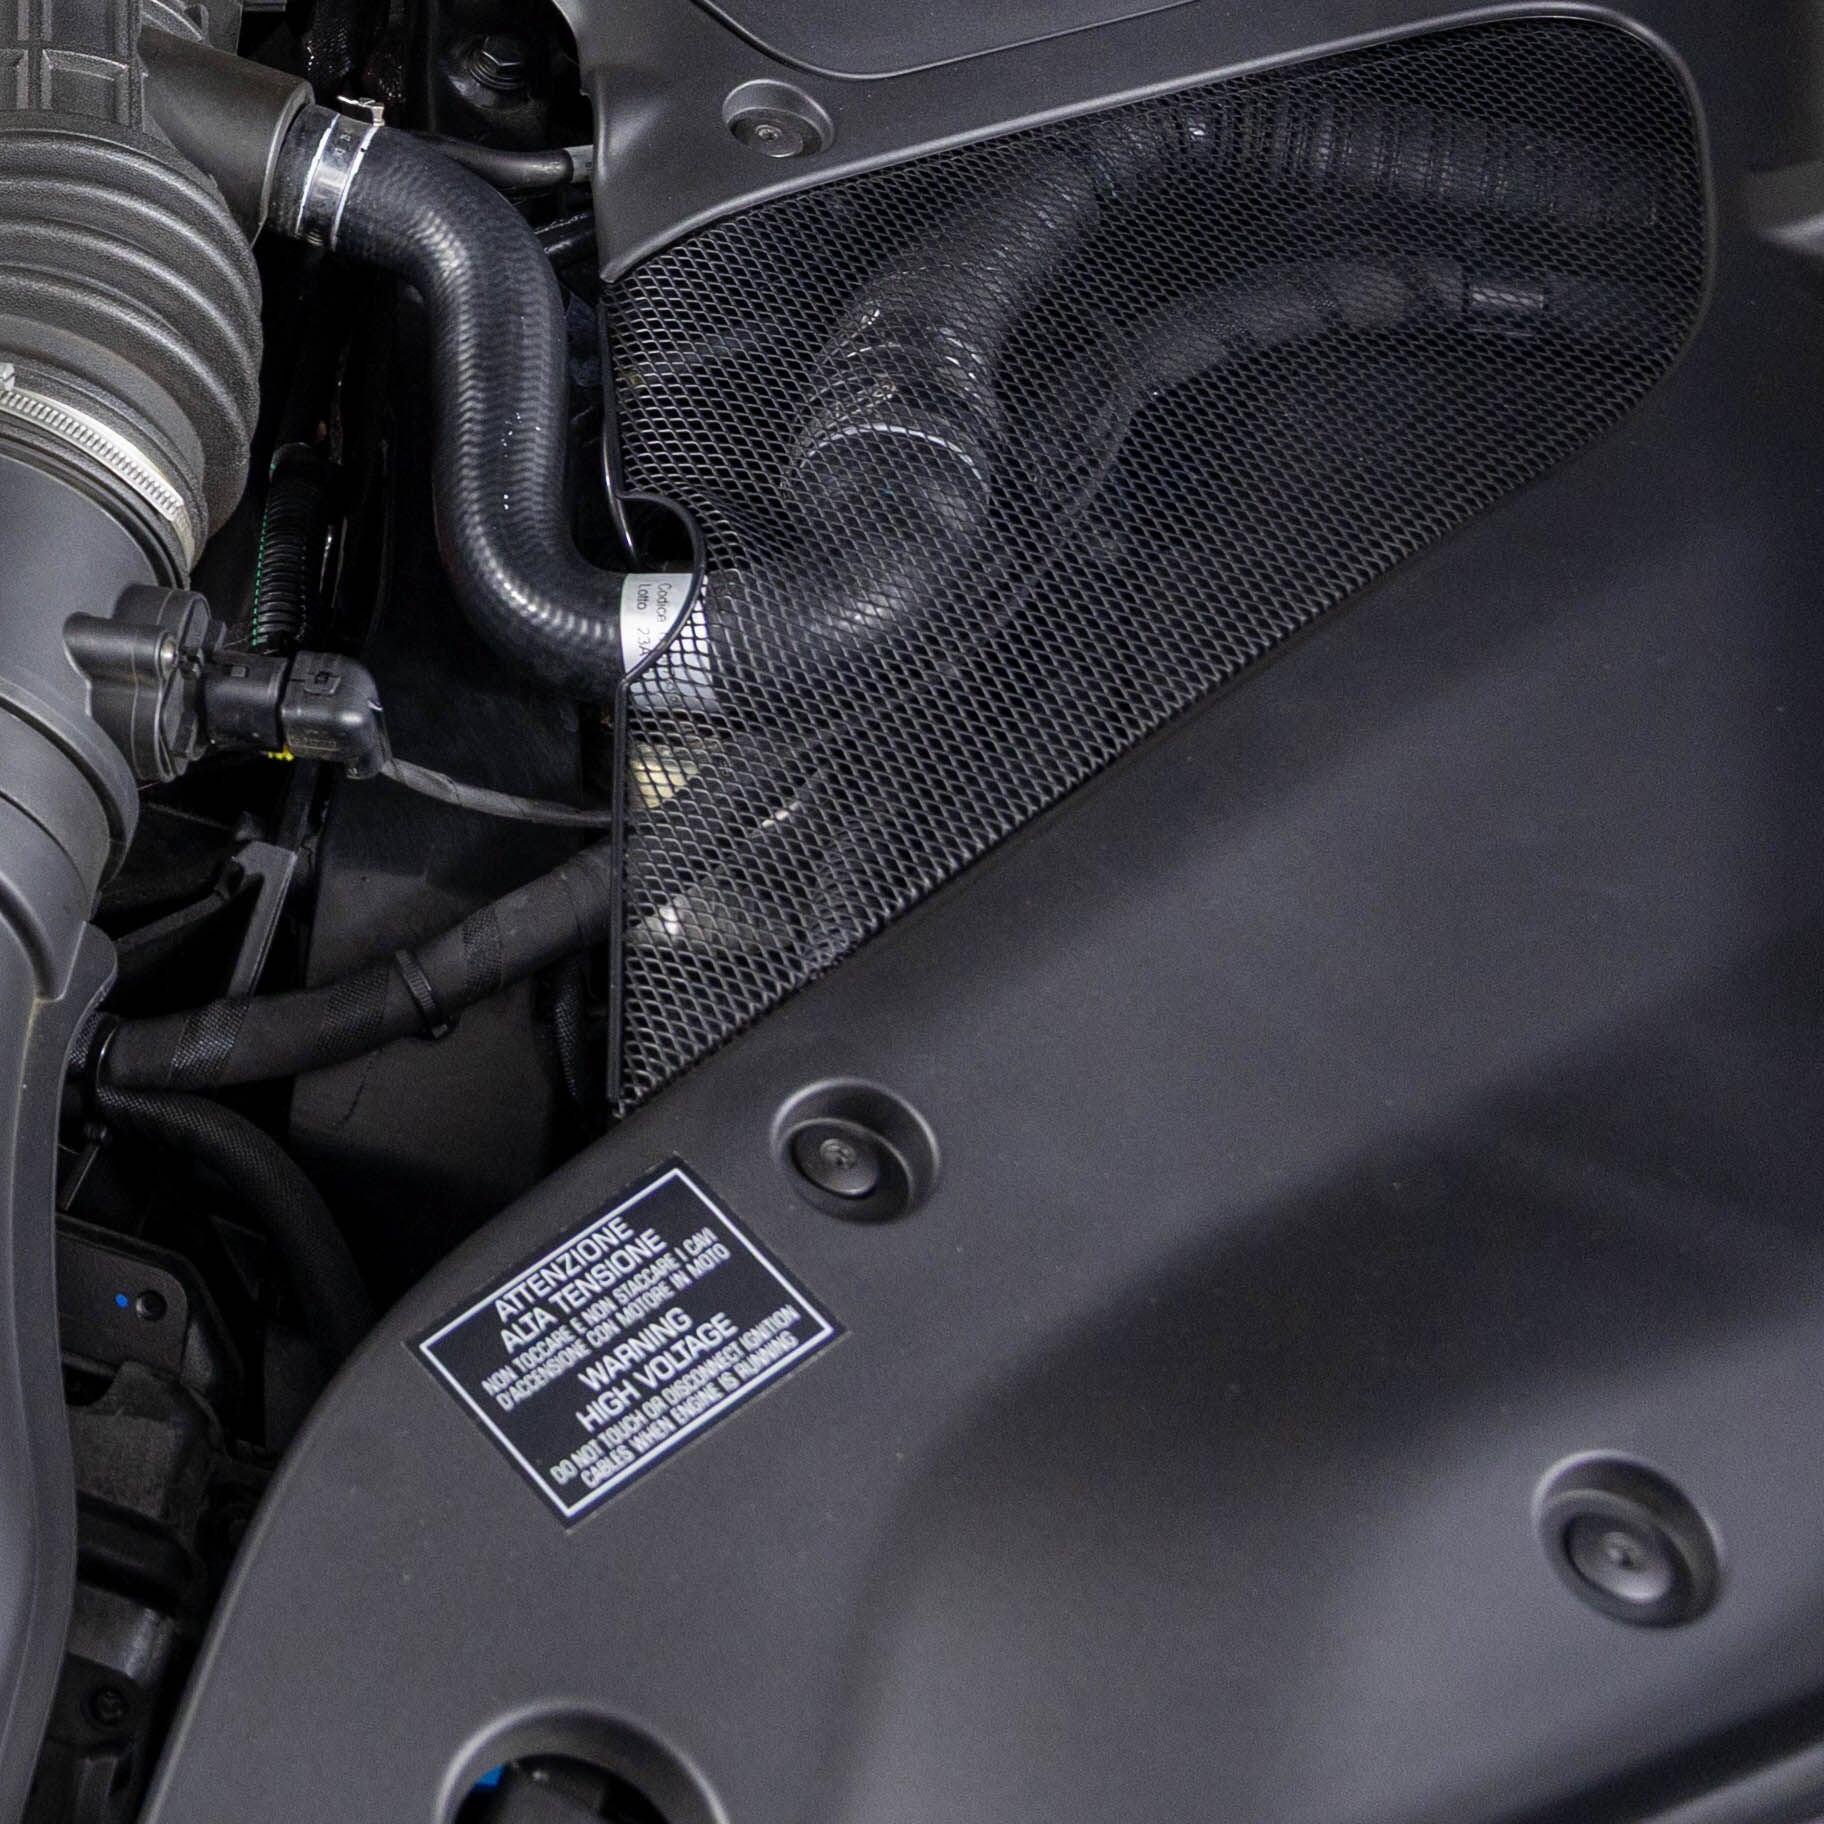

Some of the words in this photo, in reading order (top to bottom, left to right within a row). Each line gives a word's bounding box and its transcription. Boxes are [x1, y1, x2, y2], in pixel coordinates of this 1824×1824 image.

[481, 1365, 518, 1396] NON
[512, 1325, 576, 1373] TOCCARE
[569, 1316, 588, 1335] E
[581, 1296, 618, 1326] NON
[612, 1253, 682, 1306] STACCARE
[674, 1247, 689, 1263] I
[682, 1226, 719, 1255] CAVI
[494, 1216, 635, 1323] ATTENZIONE
[495, 1338, 593, 1412] D'ACCENSIONE
[585, 1318, 621, 1348] CON
[616, 1281, 676, 1329] MOTORE
[669, 1270, 694, 1291] IN
[685, 1242, 732, 1280] MOTO
[501, 1307, 558, 1354] ALTA
[548, 1228, 668, 1315] TENSIONE
[550, 1459, 578, 1485] DO
[570, 1439, 606, 1468] NOT
[597, 1408, 648, 1448] TOUCH
[641, 1395, 668, 1420] OR
[661, 1341, 746, 1405] DISCONNECT
[738, 1304, 801, 1351] IGNITION
[575, 1378, 642, 1433] HIGH
[632, 1311, 739, 1390] VOLTAGE
[577, 1307, 693, 1391] WARNING
[580, 1444, 636, 1489] CABLES
[628, 1416, 678, 1454] WHEN
[670, 1381, 725, 1426] ENGINE
[717, 1371, 740, 1393] IS
[733, 1330, 800, 1381] RUNNING
